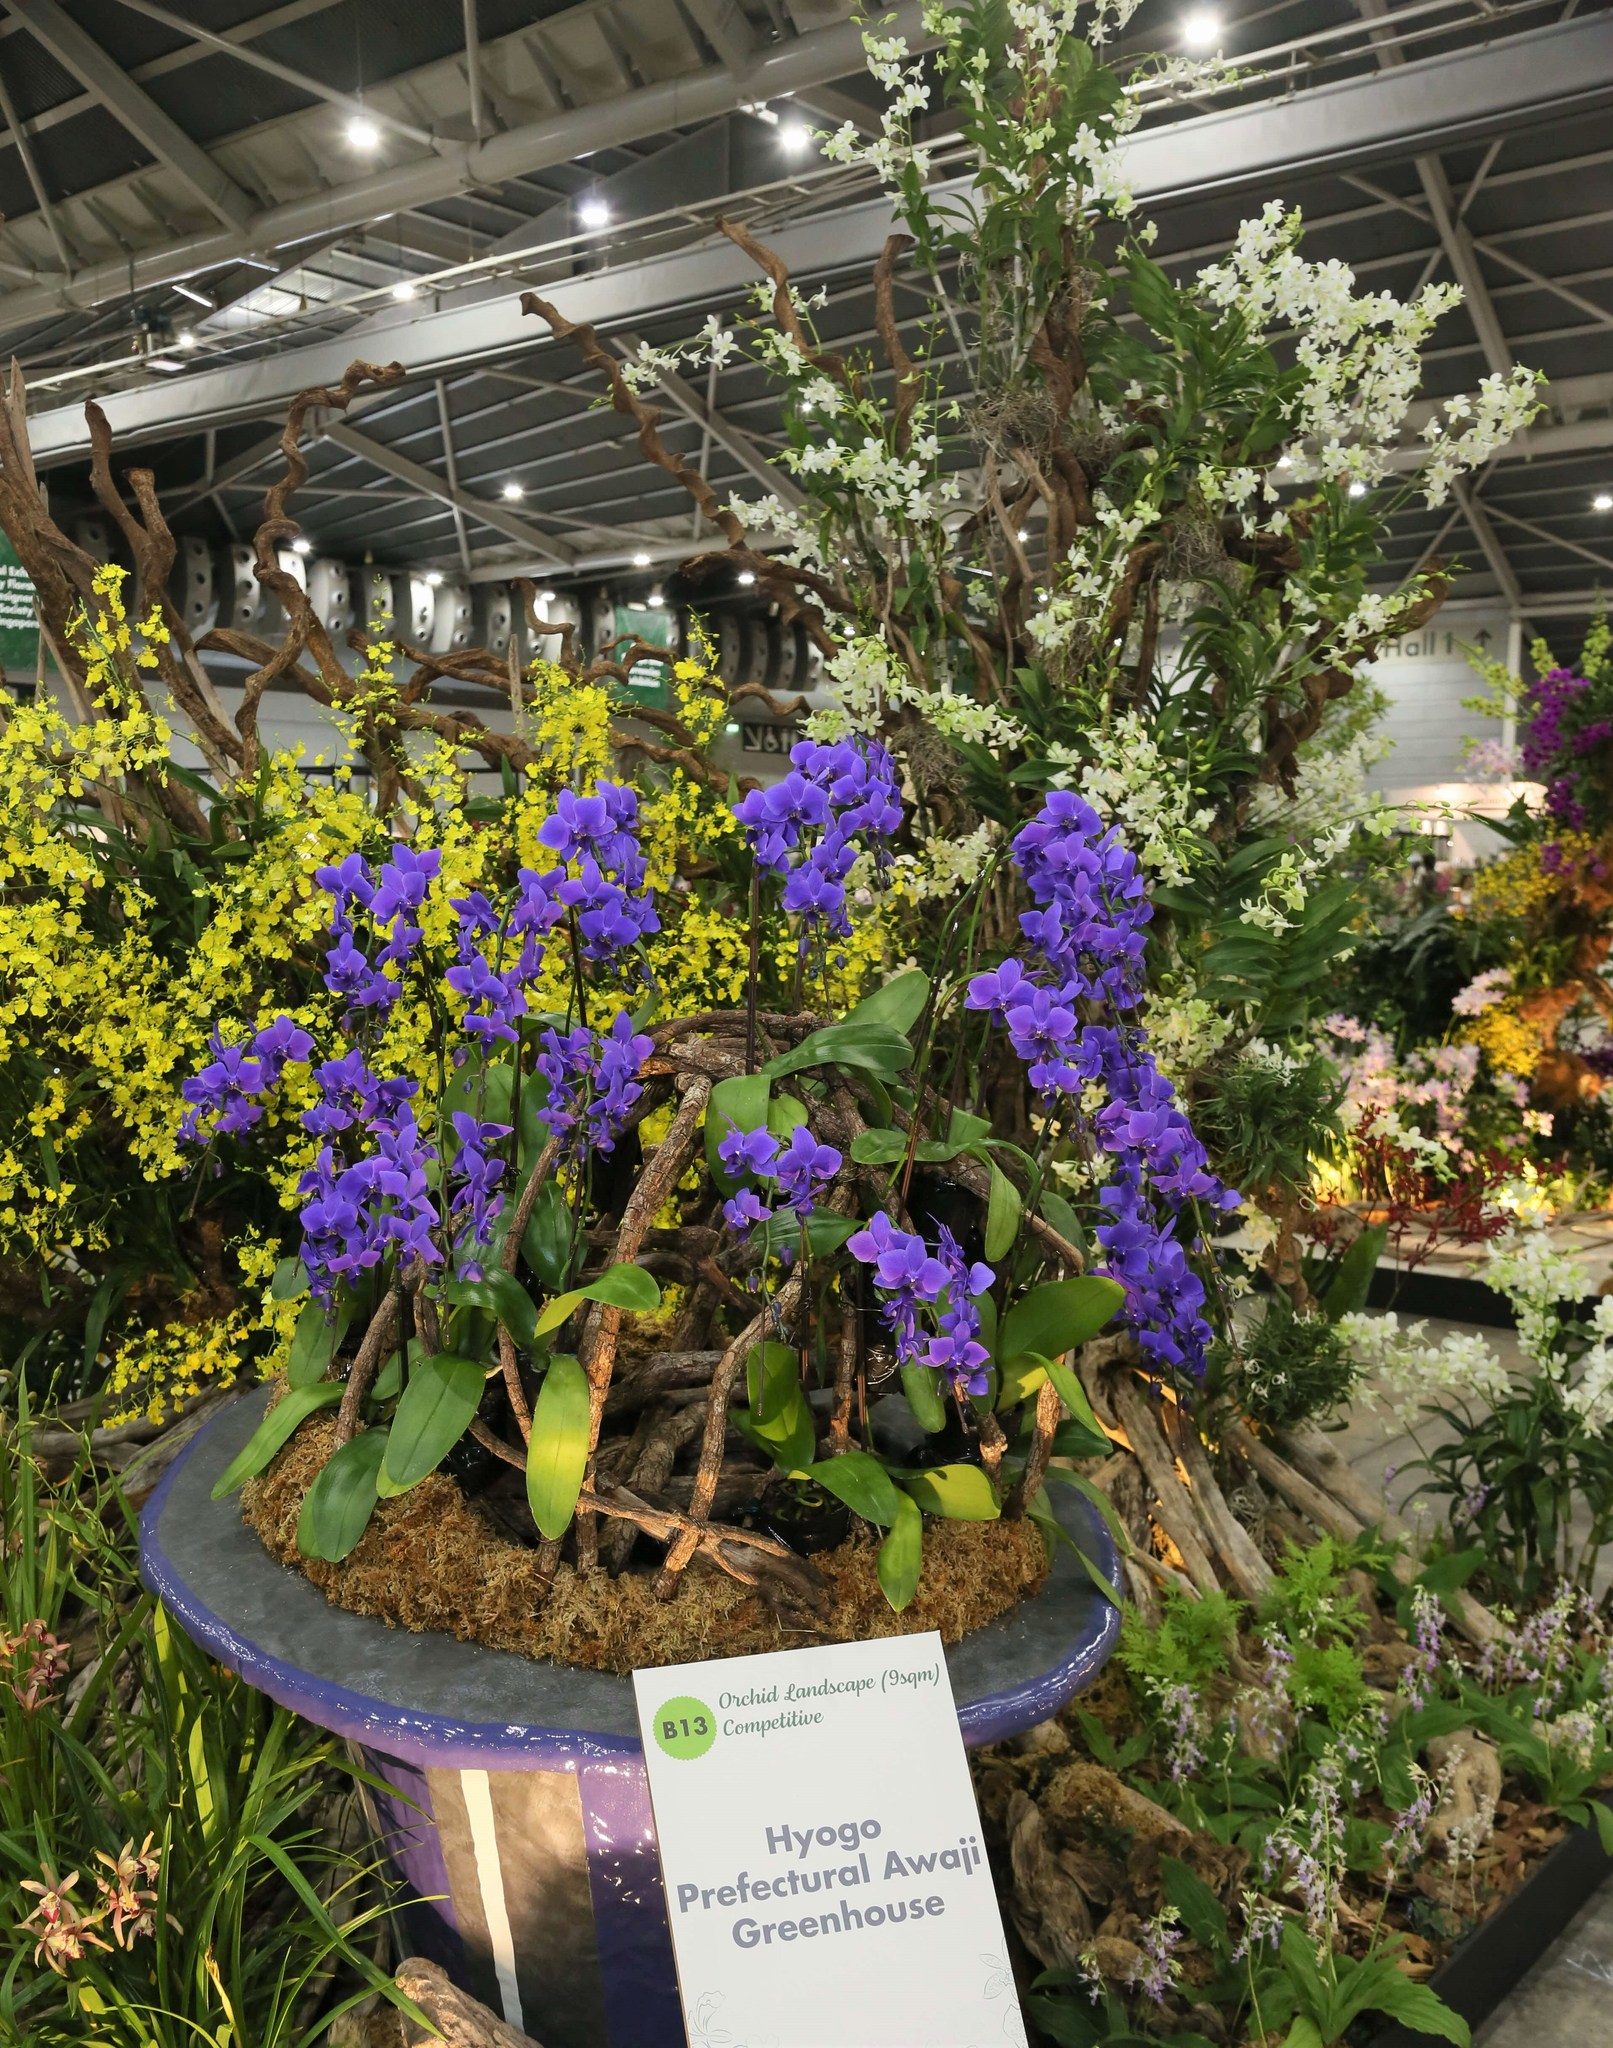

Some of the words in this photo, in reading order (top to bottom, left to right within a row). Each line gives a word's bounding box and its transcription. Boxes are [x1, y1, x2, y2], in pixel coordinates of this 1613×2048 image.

[1384, 631, 1435, 657] Hall
[719, 1685, 779, 1709] Orchid
[784, 1678, 876, 1702] Landscape
[882, 1663, 939, 1693] (9sqm)
[663, 1717, 707, 1739] B13
[724, 1710, 824, 1737] Competitive
[766, 1820, 882, 1860] Hyogo
[677, 1853, 870, 1913] Prefectural
[884, 1837, 981, 1880] Awaji
[733, 1896, 945, 1948] Greenhouse
